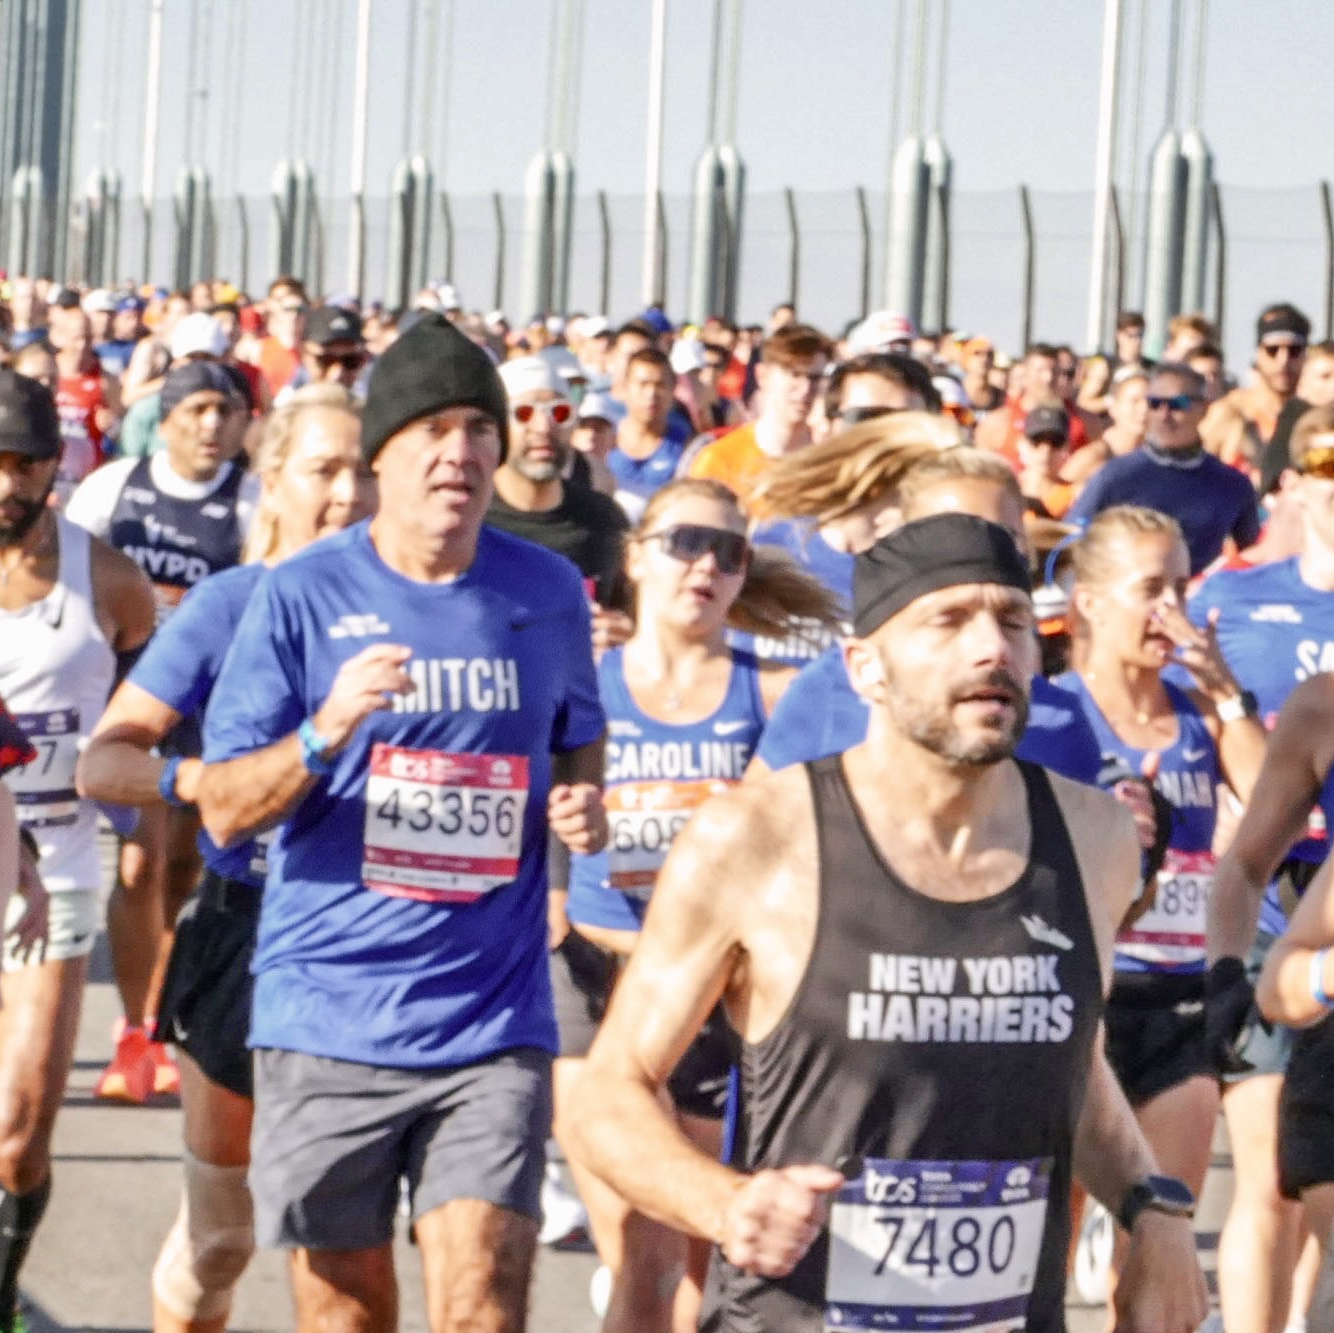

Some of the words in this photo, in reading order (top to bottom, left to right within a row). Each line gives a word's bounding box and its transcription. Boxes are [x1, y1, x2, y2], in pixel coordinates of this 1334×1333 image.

[376, 788, 516, 838] 43356
[869, 953, 957, 995] NEW
[964, 953, 1061, 995] YORK
[847, 993, 1074, 1043] HARRIERS
[873, 1214, 1016, 1278] 7480
